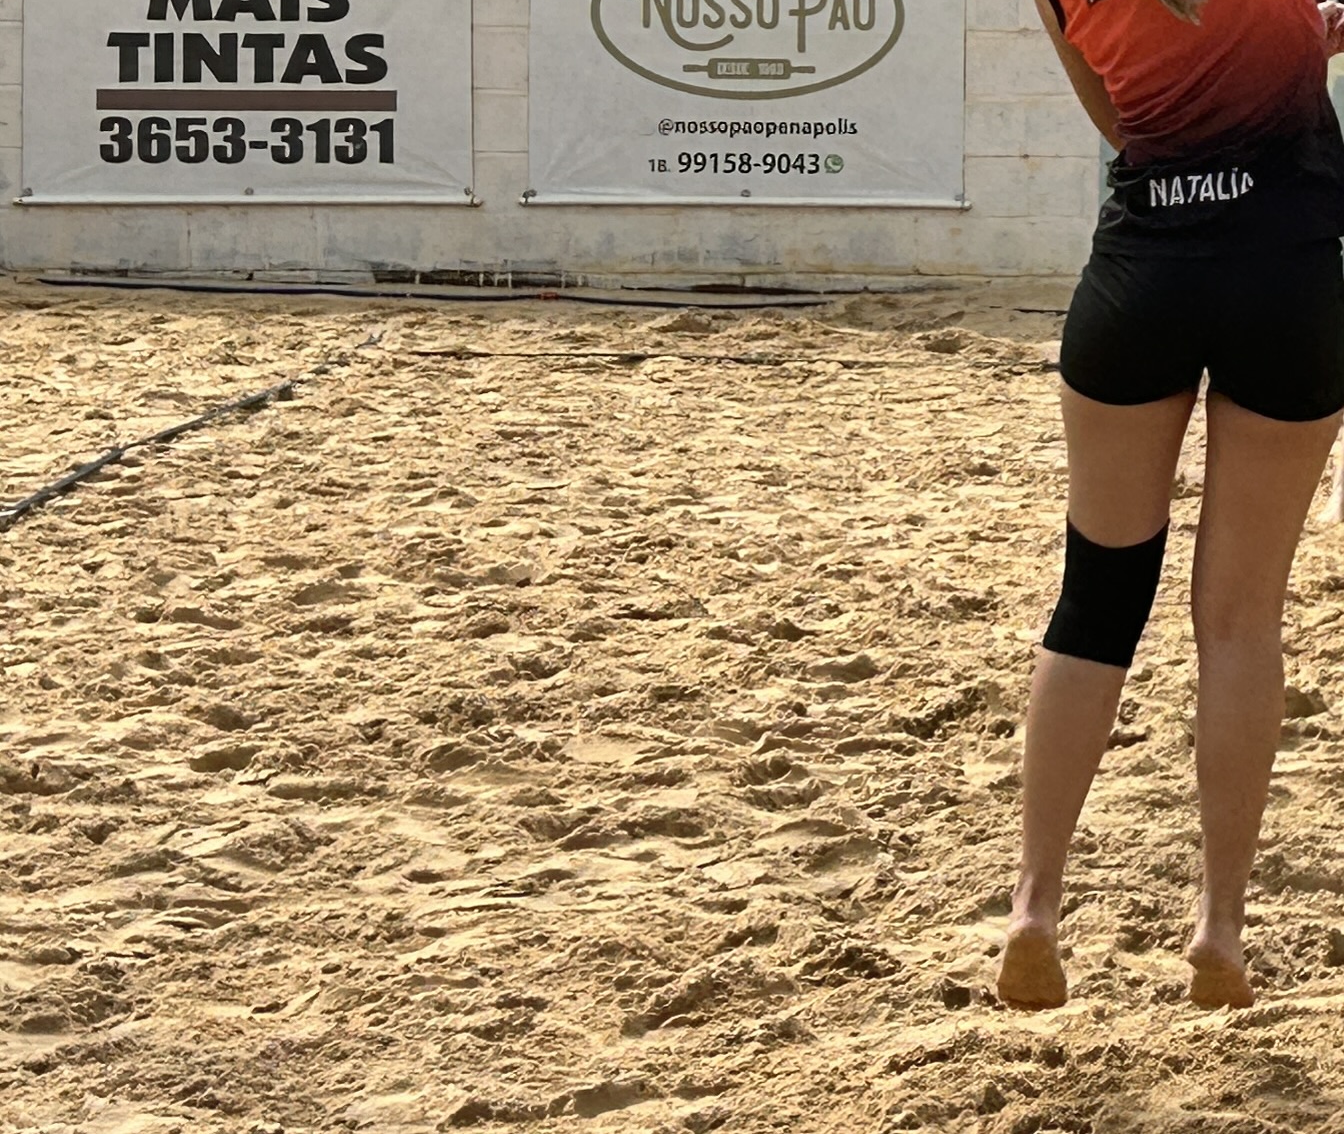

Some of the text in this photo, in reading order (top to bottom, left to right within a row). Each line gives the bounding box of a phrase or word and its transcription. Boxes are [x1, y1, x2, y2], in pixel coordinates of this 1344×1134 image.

[106, 32, 388, 84] TINTAS
[100, 116, 395, 164] 3653-3131
[658, 117, 858, 139] @nossopaopenapolis
[677, 152, 821, 174] 99158-9043
